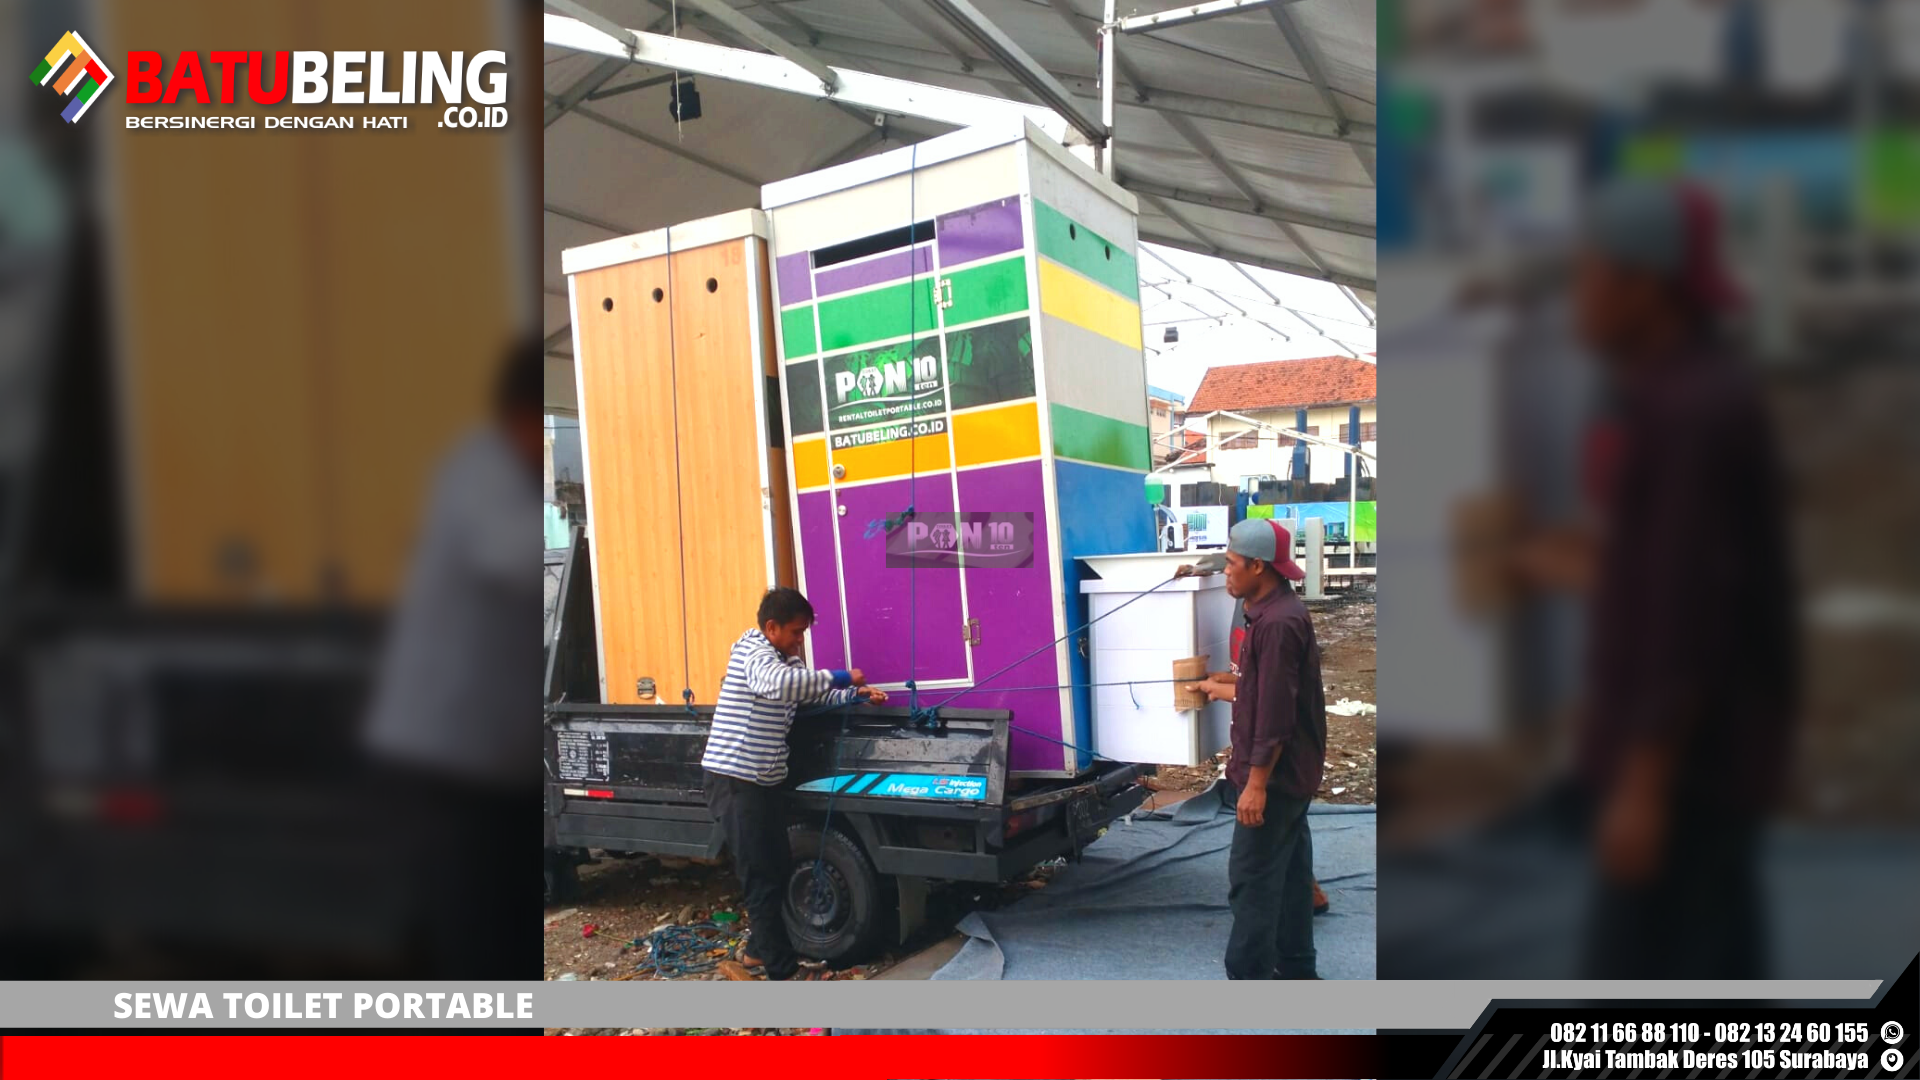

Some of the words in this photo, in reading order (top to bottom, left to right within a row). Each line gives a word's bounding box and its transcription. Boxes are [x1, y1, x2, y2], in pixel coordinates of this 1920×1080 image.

[911, 355, 937, 384] 10
[838, 399, 943, 423] RENTALTOILETPORTABLE.CO.ID
[834, 420, 944, 448] BATUBELING.CO.ID
[887, 783, 930, 796] Mega
[934, 785, 980, 797] Cargo
